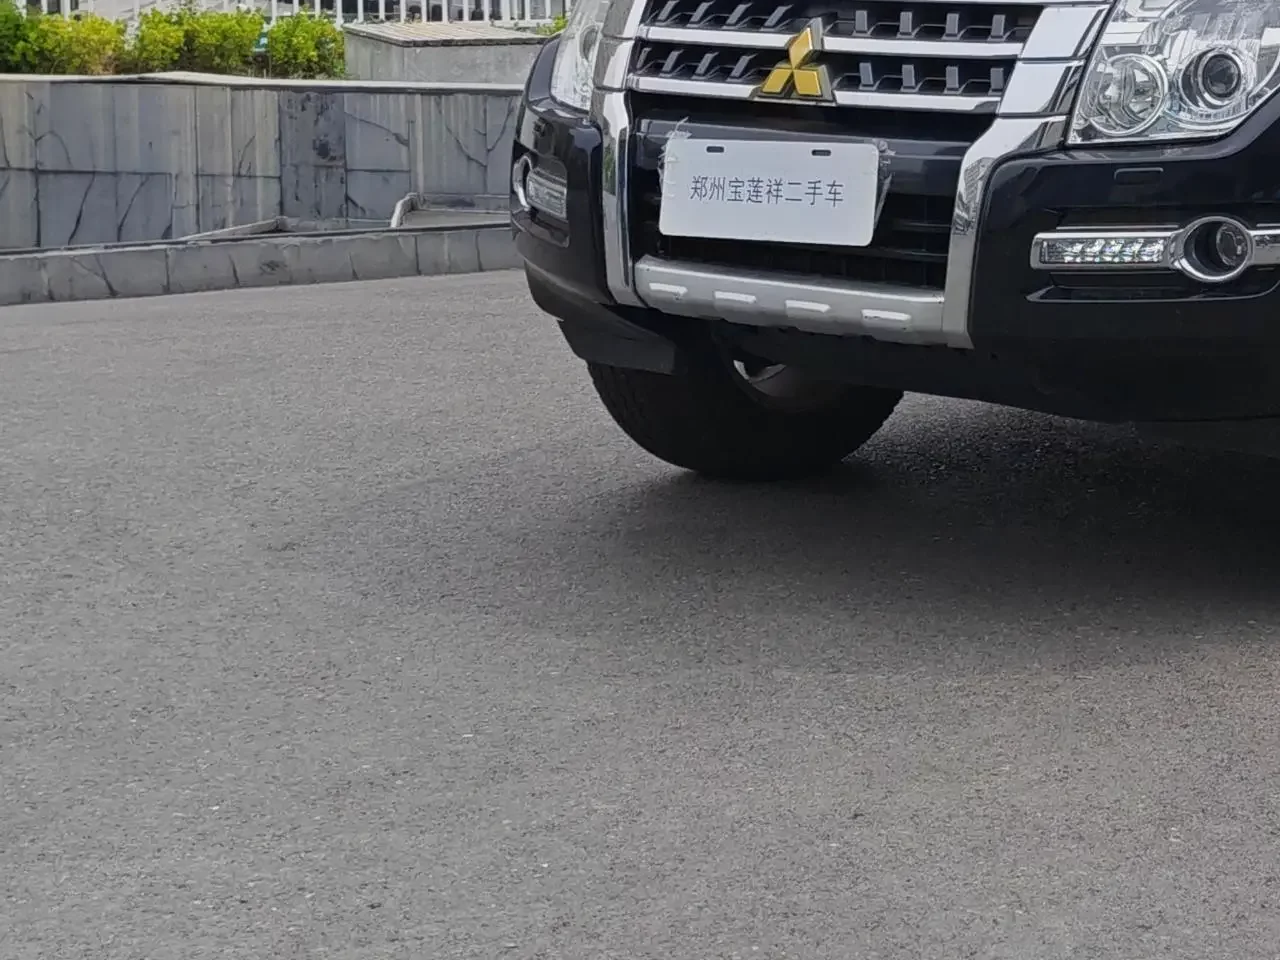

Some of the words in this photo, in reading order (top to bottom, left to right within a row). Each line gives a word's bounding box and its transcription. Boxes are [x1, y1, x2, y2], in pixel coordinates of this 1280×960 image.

[689, 175, 845, 208] 郑州宝莲祥二手车
